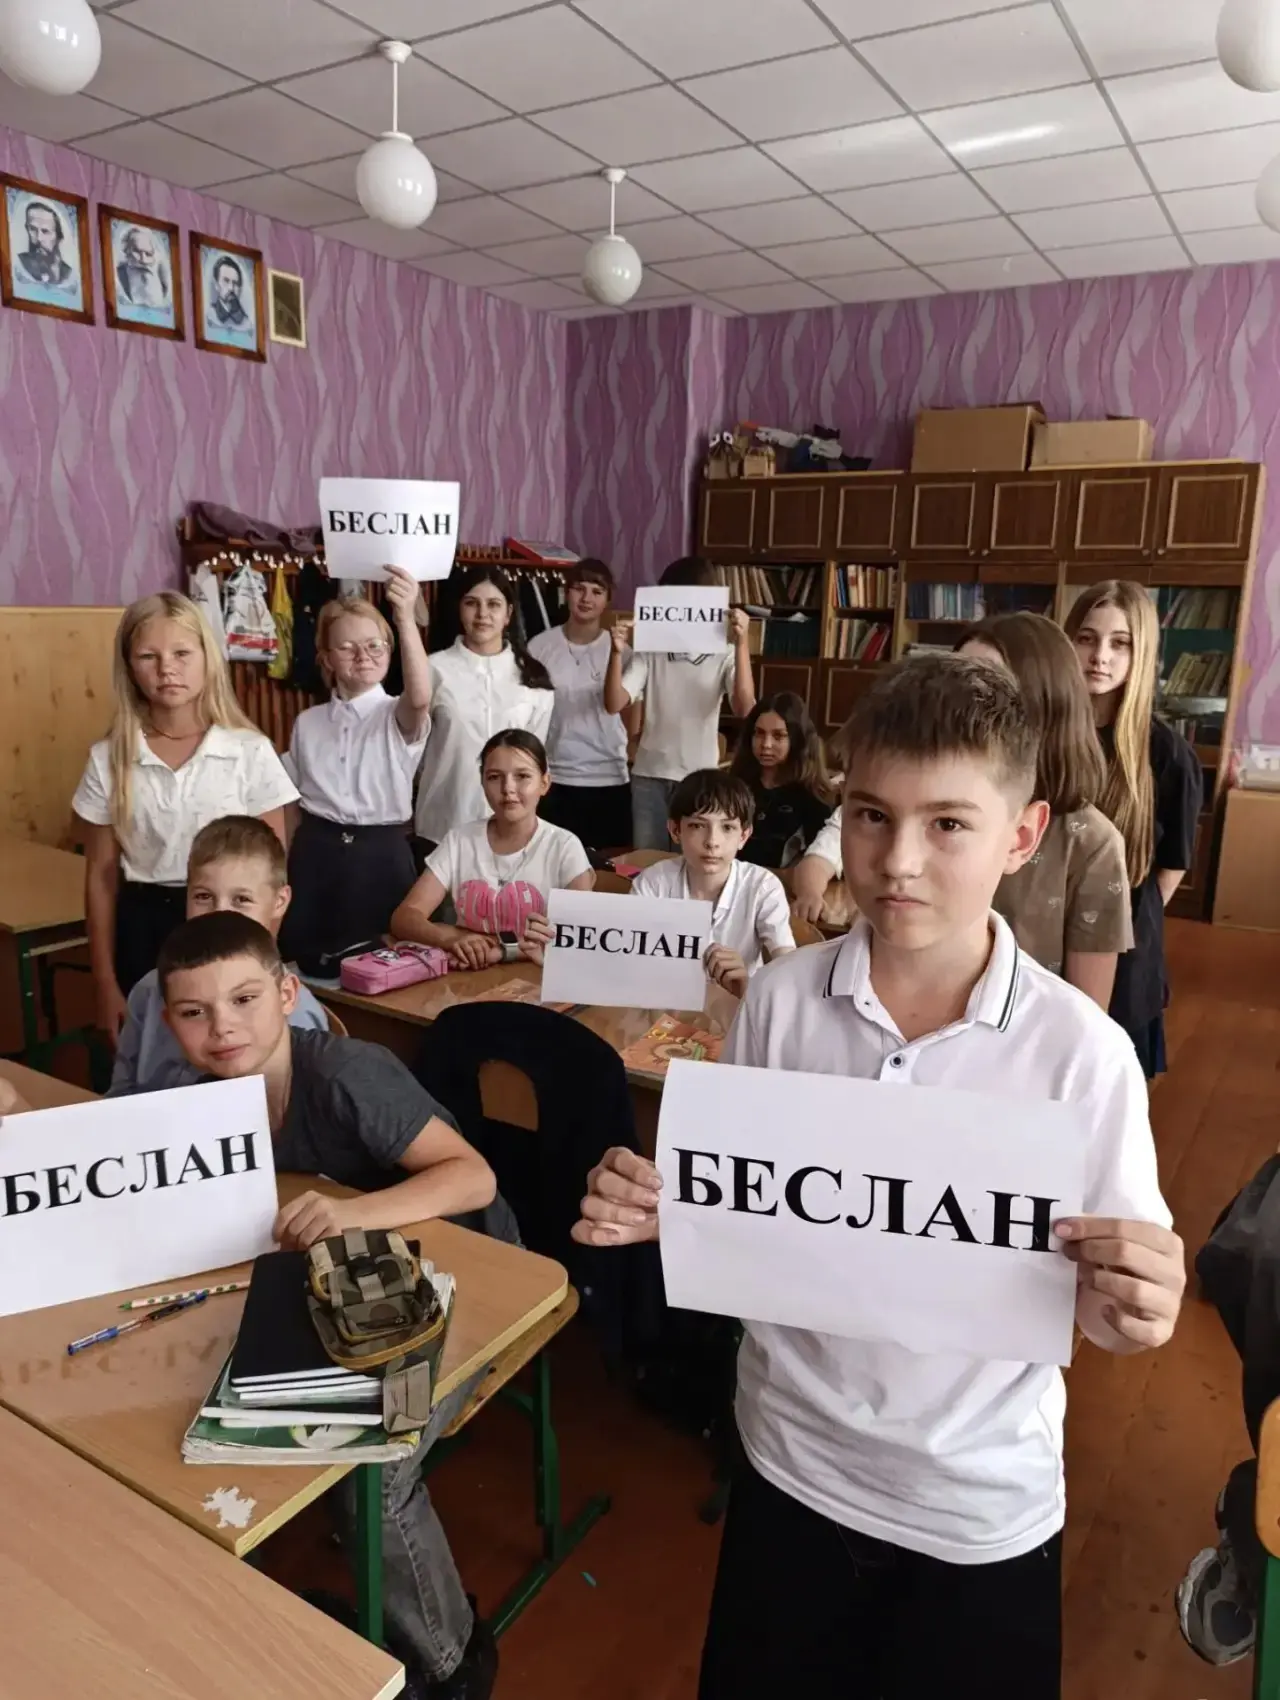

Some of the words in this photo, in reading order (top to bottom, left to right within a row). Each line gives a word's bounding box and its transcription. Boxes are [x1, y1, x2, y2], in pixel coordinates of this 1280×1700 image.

[328, 510, 452, 535] БЕСЛАН
[639, 606, 723, 623] БЕСЛАН
[552, 922, 702, 960] БЕСЛАН
[1, 1131, 261, 1217] БЕСЛАН
[672, 1147, 1061, 1253] БЕСЛАН
